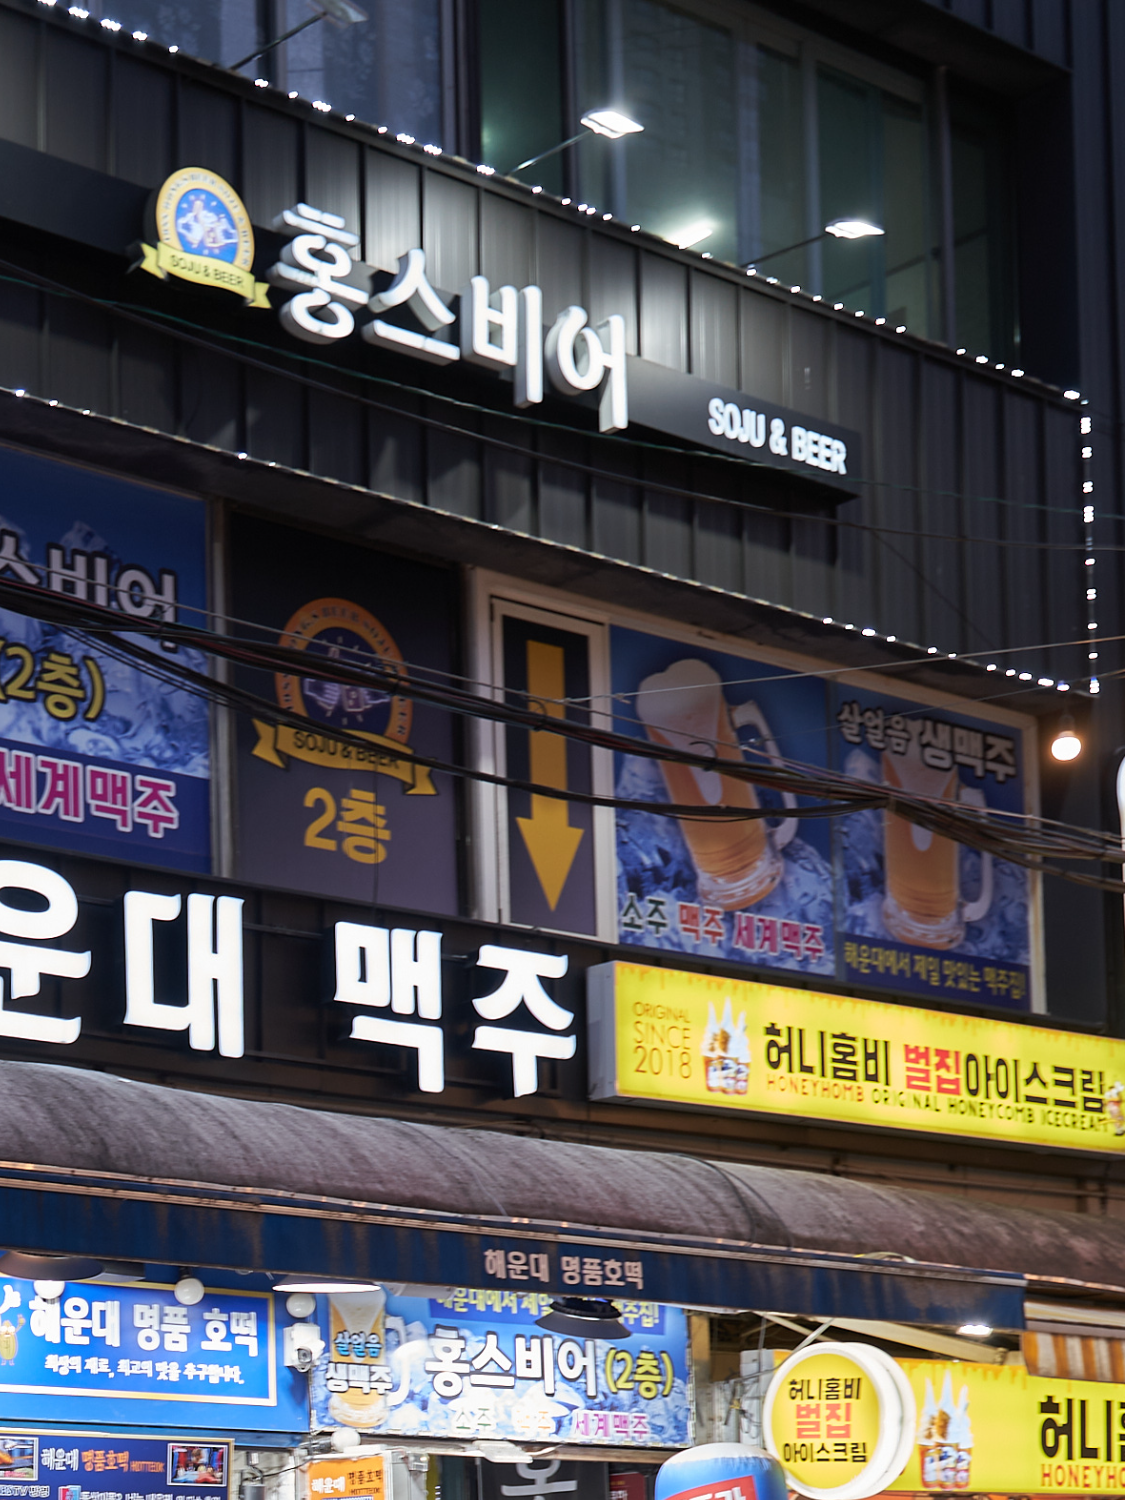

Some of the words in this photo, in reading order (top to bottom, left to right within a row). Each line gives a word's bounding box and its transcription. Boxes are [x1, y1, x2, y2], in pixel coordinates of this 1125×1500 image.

[169, 254, 202, 276] SOJU
[203, 264, 211, 277] &
[213, 268, 244, 289] BEER
[278, 203, 629, 434] 홍스비어
[707, 397, 766, 449] SOJU
[769, 419, 788, 460] &
[792, 426, 847, 475] BEER
[292, 730, 336, 757] SOJU
[837, 701, 912, 755] 살얼음
[920, 718, 1018, 784] 생맥주
[303, 786, 392, 864] 2층
[622, 890, 668, 936] 소주
[677, 901, 725, 946] 맥주
[732, 911, 825, 961] 세계맥주
[843, 940, 912, 978] 해운대에서
[913, 953, 941, 987] 제일
[942, 958, 982, 993] 맛있는
[333, 920, 578, 1098] 맥주
[632, 1001, 691, 1024] ORIGINAL
[633, 1021, 692, 1051] SINCE
[633, 1046, 693, 1079] 2018
[764, 1022, 891, 1087] 허니홈비
[765, 1073, 864, 1103] HONEYHOMB
[872, 1087, 943, 1114] ORIGINAL
[947, 1097, 1036, 1124] HONEYCOMB
[1040, 1108, 1110, 1134] ICECREAM
[484, 1248, 550, 1284] 해운대
[560, 1255, 645, 1290] 명품호떡
[29, 1293, 121, 1348] 해운대
[133, 1303, 192, 1353] 명품
[200, 1307, 259, 1358] 호떡
[333, 1329, 383, 1358] 살얼음
[44, 1354, 82, 1376] 최상의
[117, 1358, 153, 1378] 최고의
[326, 1360, 393, 1395] 생맥주
[425, 1323, 597, 1399] 홍스비어
[605, 1347, 674, 1400] (2층)
[788, 1377, 861, 1402] 허니홈비
[454, 1405, 497, 1435] 소주
[573, 1408, 651, 1440] 세계맥주
[795, 1402, 852, 1440] 벌집
[41, 1447, 80, 1472] 해운대
[81, 1449, 130, 1473] 명품호떡
[783, 1441, 869, 1464] 아이스크림
[311, 1476, 346, 1494] 해운대
